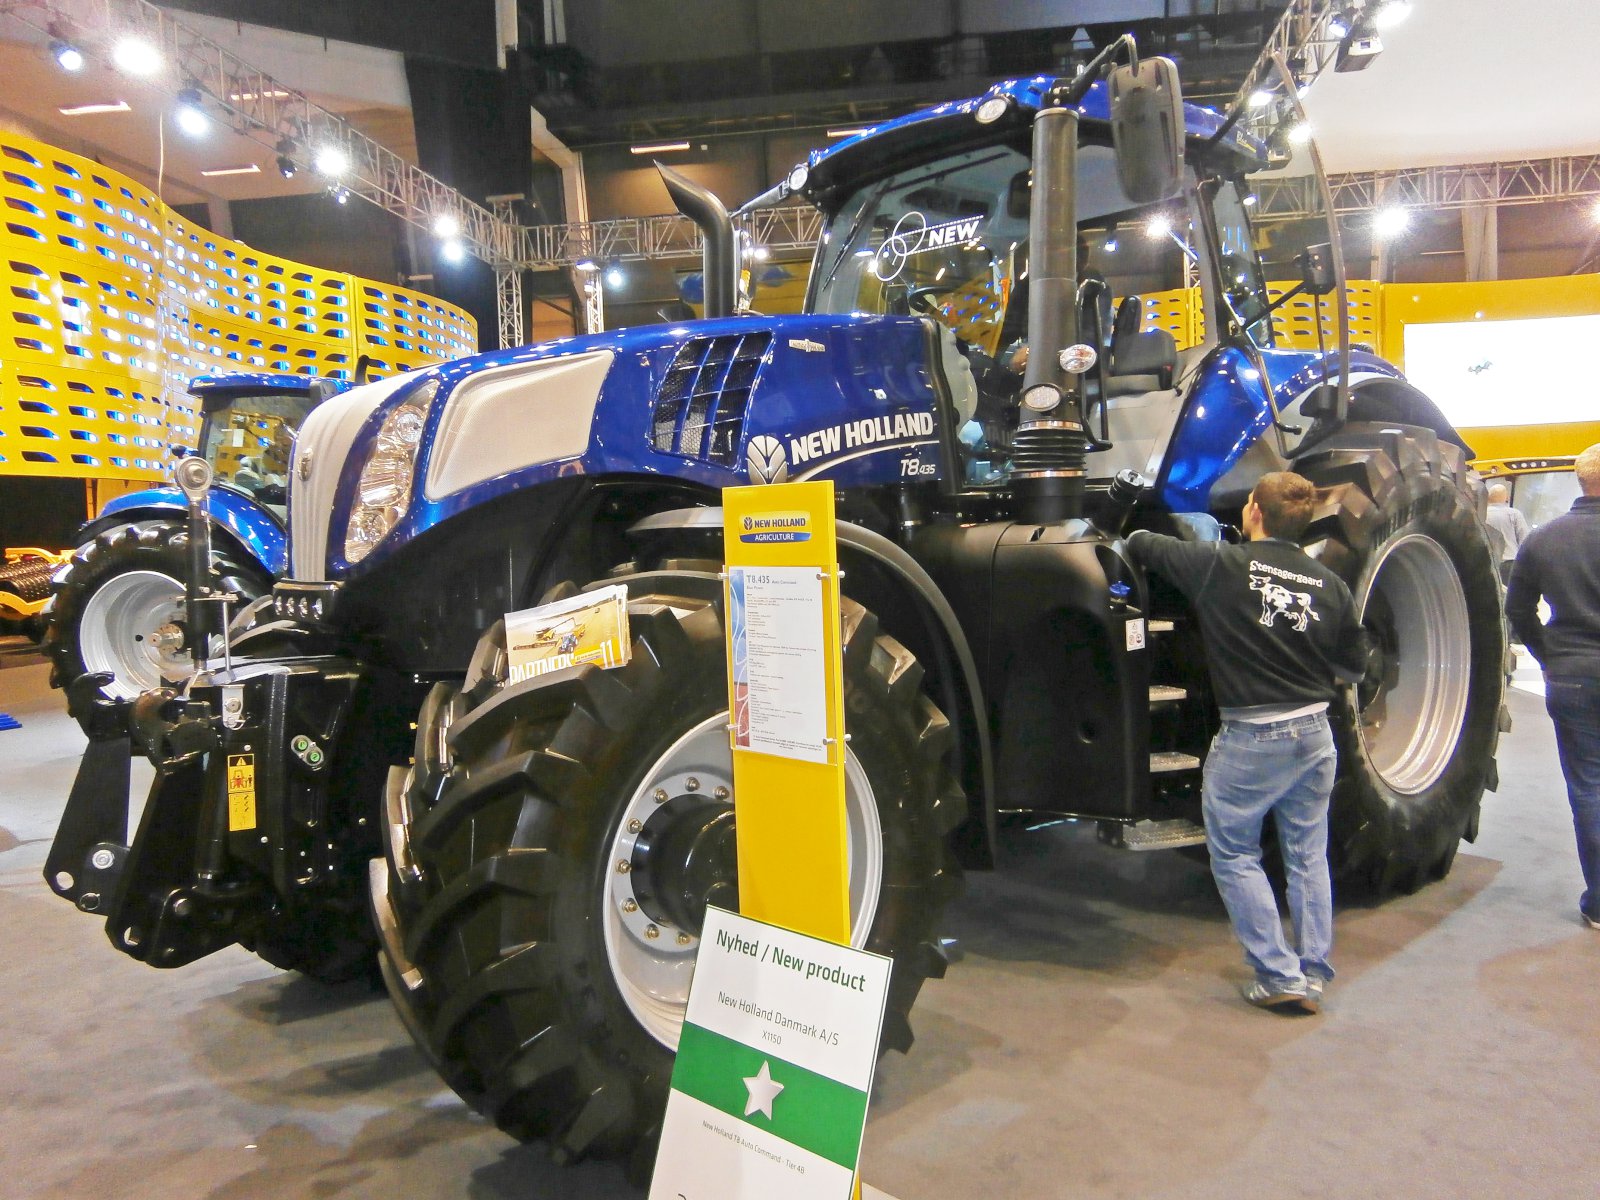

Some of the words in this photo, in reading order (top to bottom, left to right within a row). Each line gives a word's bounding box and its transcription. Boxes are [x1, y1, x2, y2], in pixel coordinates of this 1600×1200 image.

[928, 220, 979, 247] NEW
[790, 426, 841, 465] NEW
[845, 412, 934, 448] HOLLAND
[754, 519, 771, 528] NEW
[772, 518, 806, 527] HOLLAND
[755, 533, 794, 541] AGRICULTURE
[746, 574, 770, 584] T8.435
[1249, 560, 1323, 587] Stensagergaard
[600, 640, 615, 668] 11
[716, 929, 759, 957] Nyhed
[760, 944, 770, 962] /
[772, 946, 804, 972] New
[806, 961, 866, 992] product
[718, 991, 738, 1009] New
[738, 1000, 773, 1022] Holland
[774, 1012, 817, 1038] Danmark
[819, 1028, 840, 1046] A/S
[762, 1030, 782, 1045] X1150
[702, 1120, 713, 1131] New
[714, 1125, 733, 1140] Holland
[741, 1138, 754, 1150] Auto
[754, 1145, 781, 1163] Command
[786, 1159, 797, 1170] Tier
